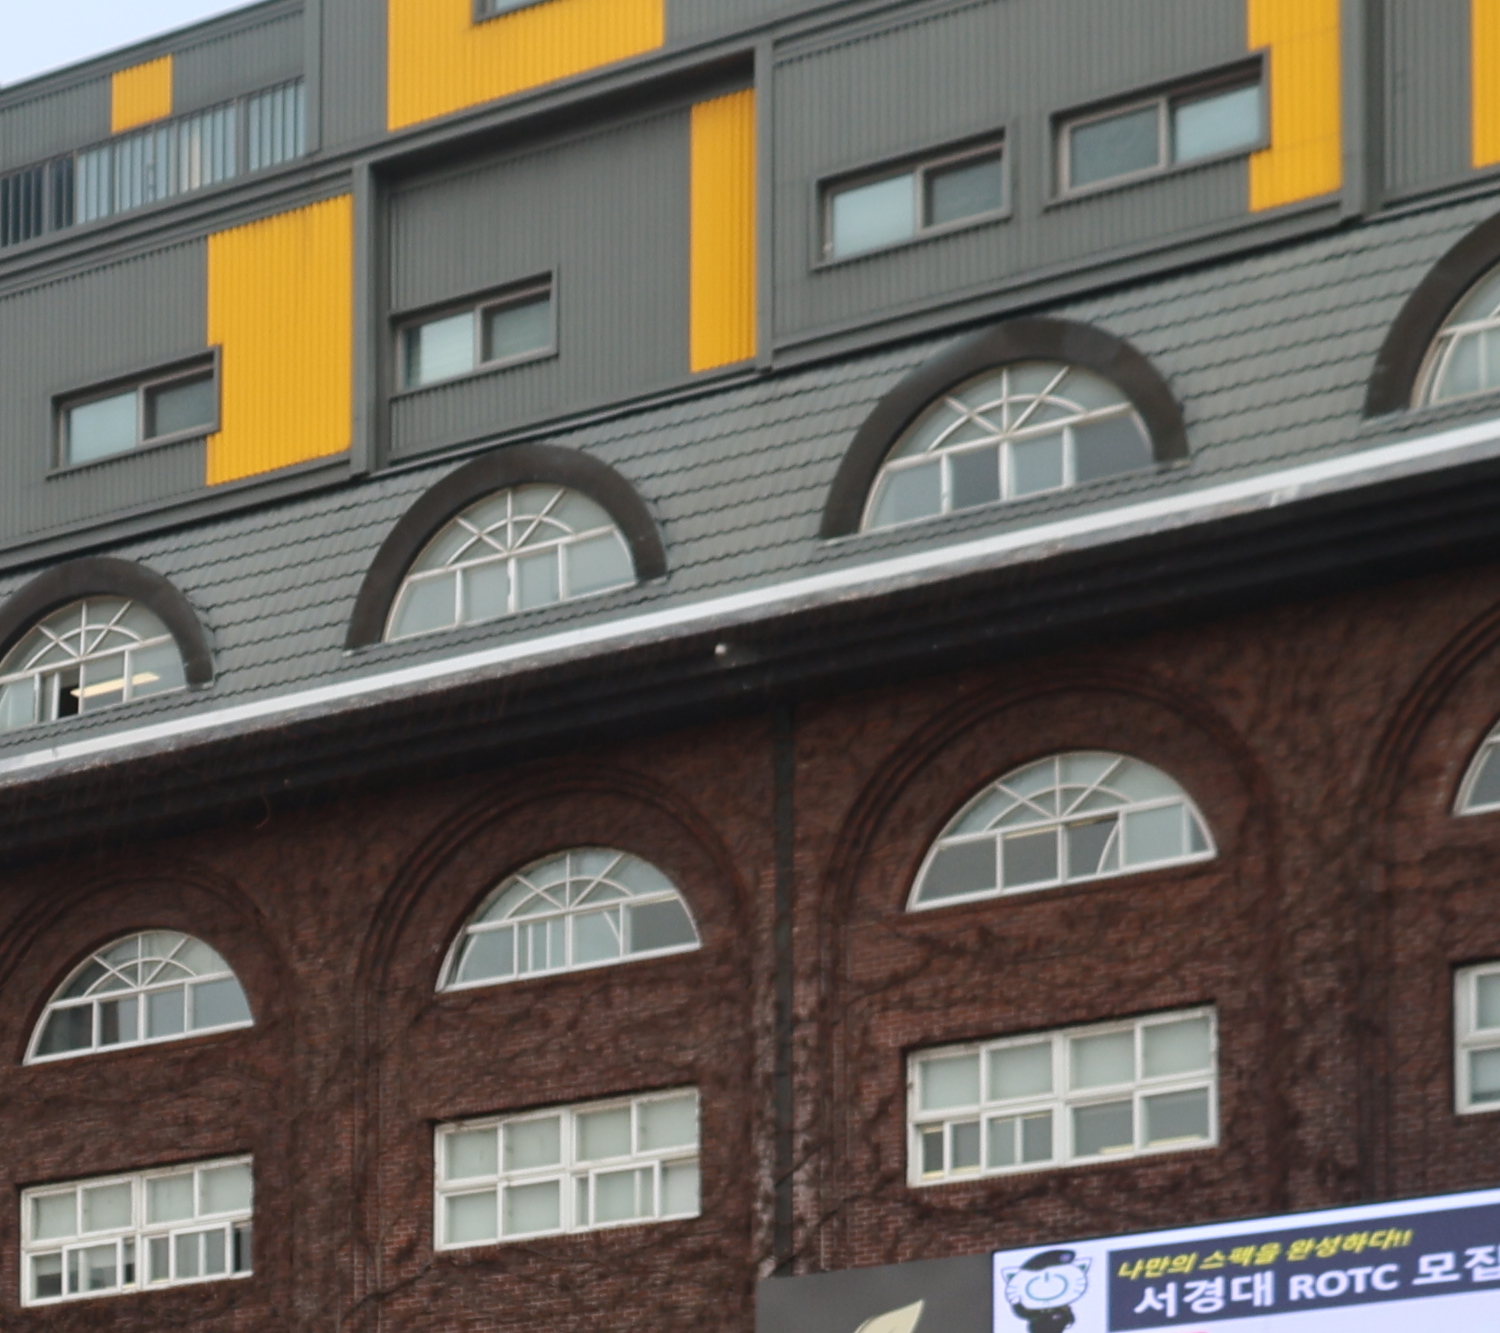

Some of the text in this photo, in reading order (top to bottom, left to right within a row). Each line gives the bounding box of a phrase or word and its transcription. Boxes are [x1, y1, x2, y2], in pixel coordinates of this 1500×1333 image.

[1117, 1252, 1197, 1281] 나만의
[1133, 1271, 1275, 1317] 서경대
[1288, 1263, 1400, 1302] ROTC
